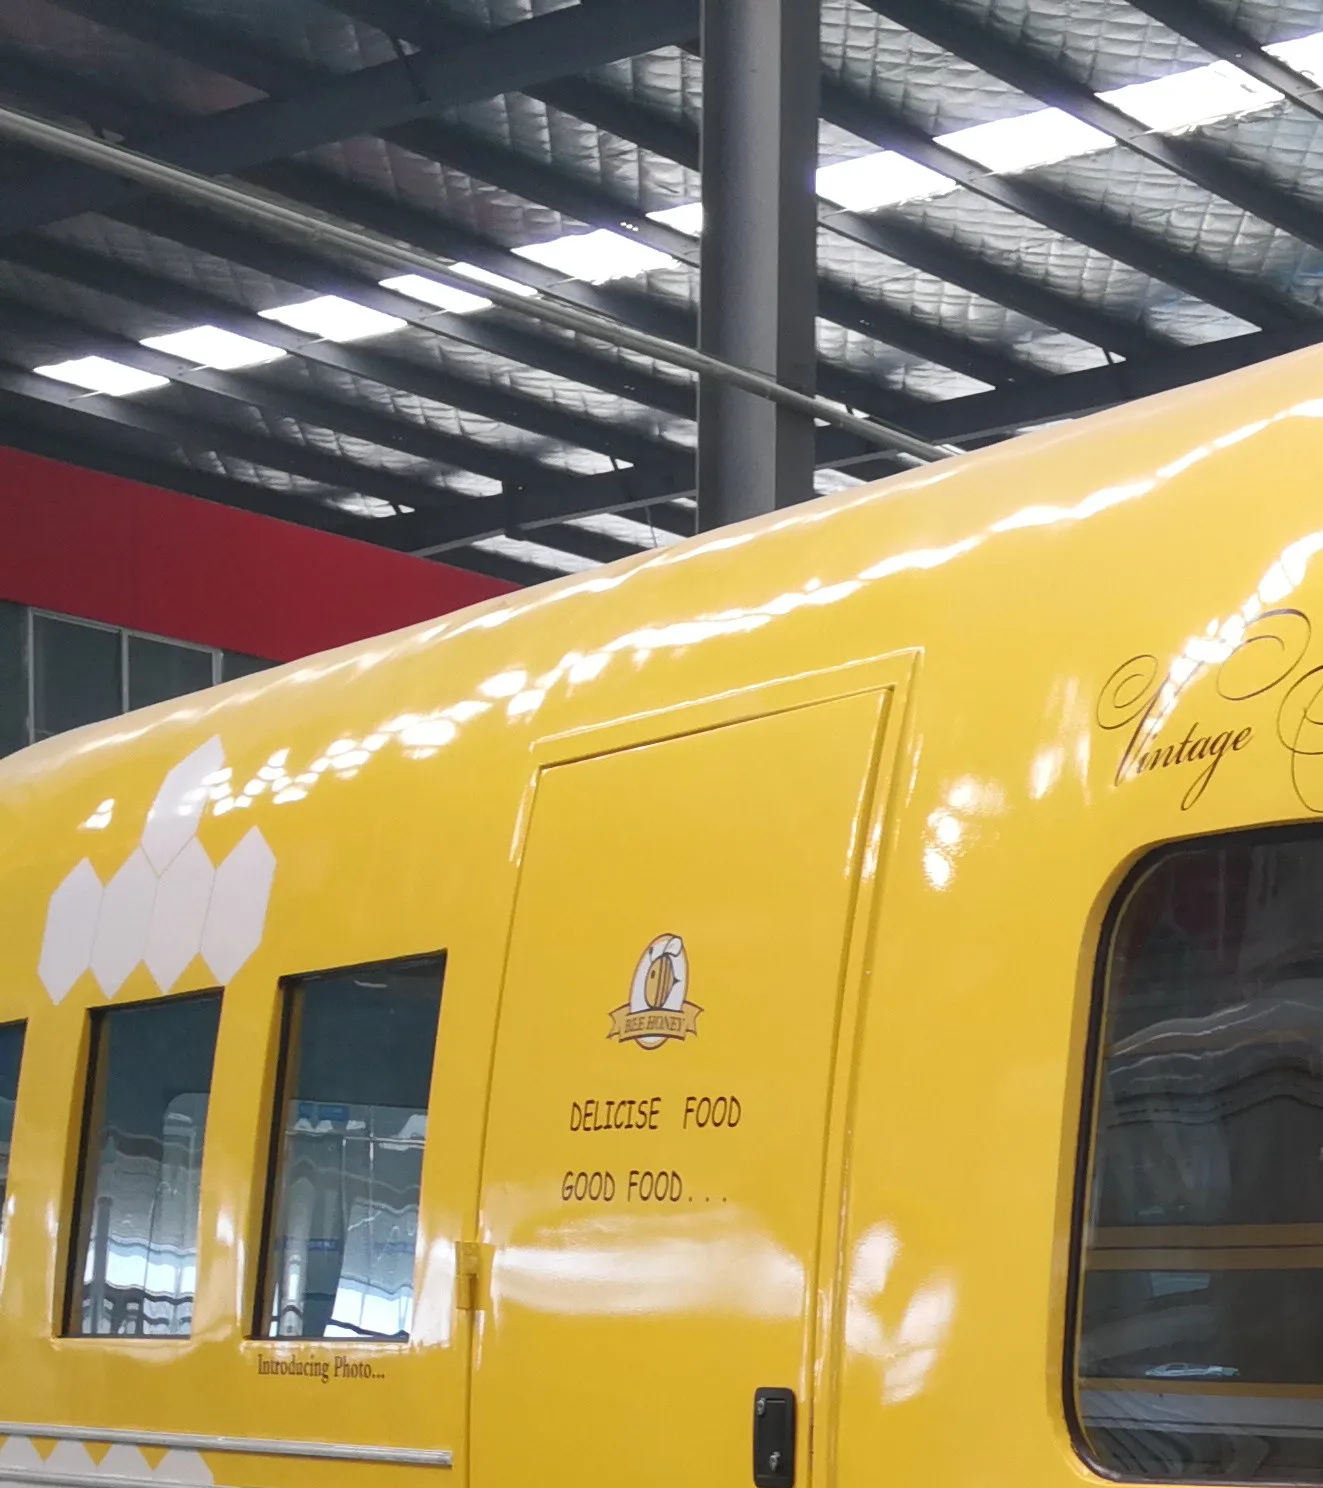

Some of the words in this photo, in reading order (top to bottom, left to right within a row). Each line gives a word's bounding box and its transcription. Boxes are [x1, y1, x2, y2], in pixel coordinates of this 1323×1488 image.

[1096, 608, 1312, 811] Vintage
[625, 1016, 646, 1033] BEE
[646, 1015, 686, 1032] HONEY
[569, 1096, 662, 1132] DELICISE
[682, 1095, 742, 1130] FOOD
[561, 1170, 616, 1202] GOOD
[257, 1353, 330, 1385] Introducing
[333, 1355, 386, 1380] Photo...
